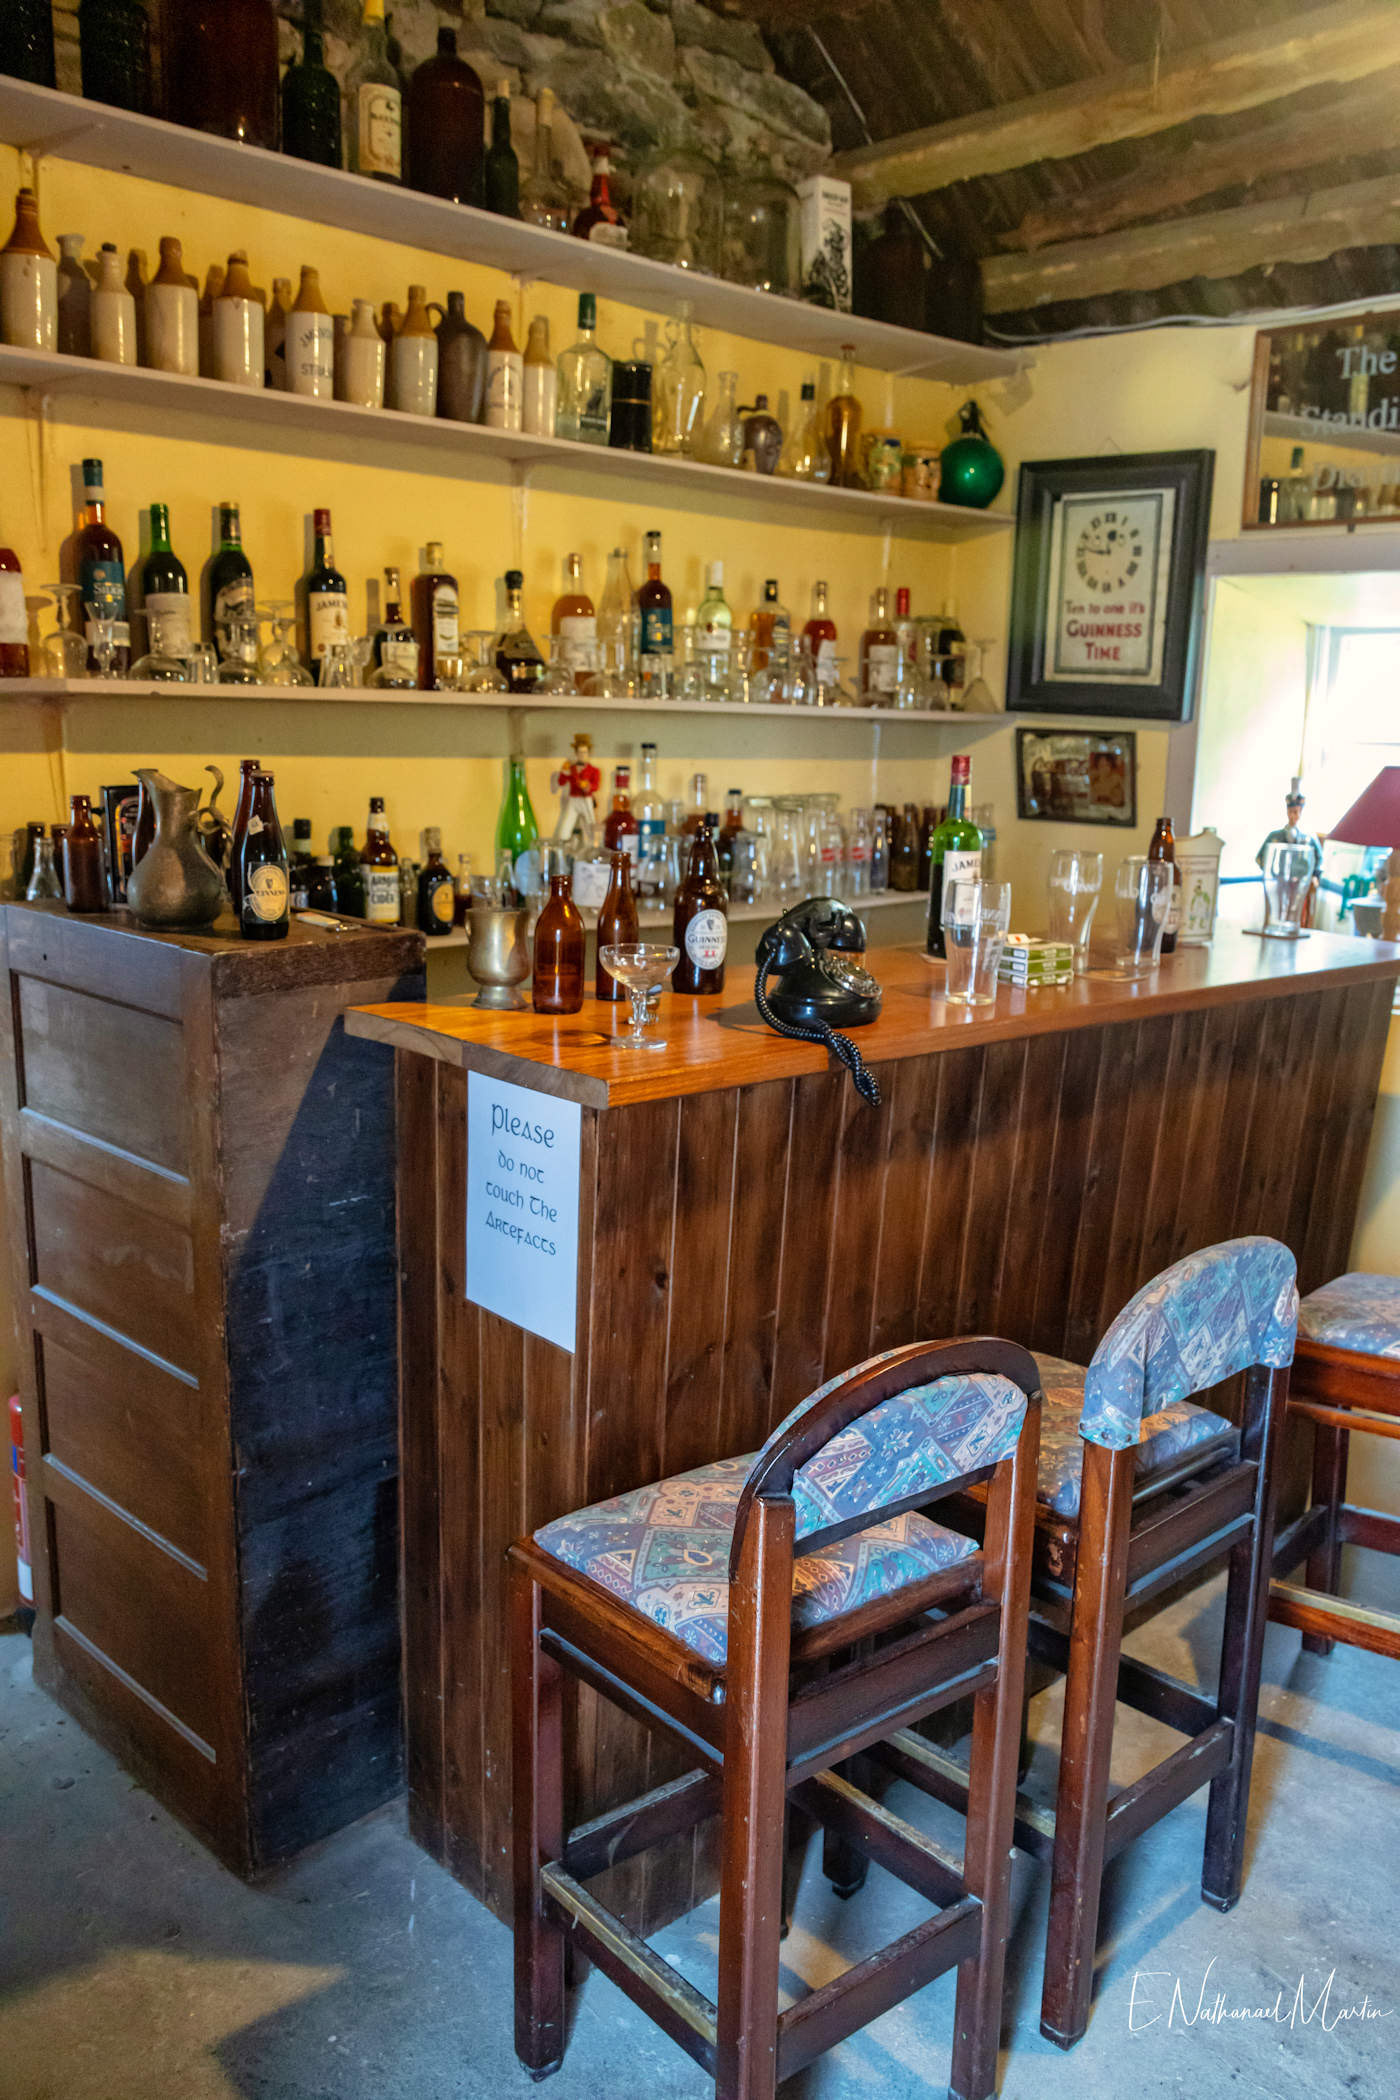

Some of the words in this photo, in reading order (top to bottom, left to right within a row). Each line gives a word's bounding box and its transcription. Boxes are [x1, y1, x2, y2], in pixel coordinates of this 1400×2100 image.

[1336, 344, 1397, 380] The
[1065, 599, 1085, 615] Ten
[1088, 603, 1101, 614] to
[1103, 605, 1125, 614] one
[1066, 618, 1143, 638] GUINNESS
[1085, 640, 1121, 662] TIME
[492, 1103, 555, 1148] Please
[498, 1149, 515, 1172] do
[519, 1162, 544, 1184] not
[485, 1181, 524, 1209] touch
[529, 1195, 557, 1223] The
